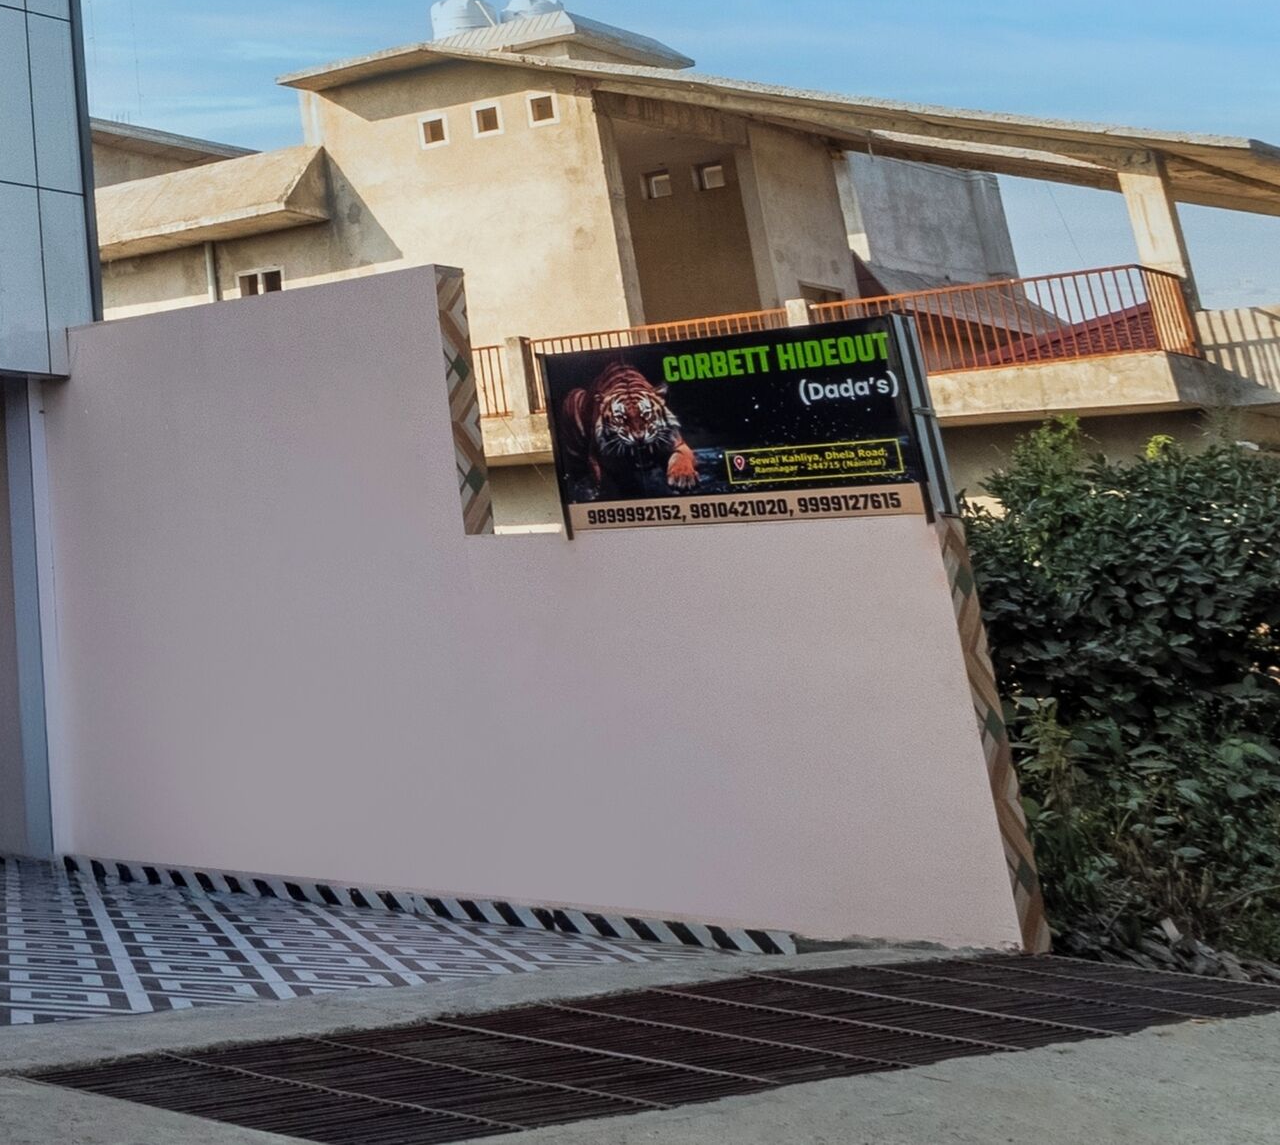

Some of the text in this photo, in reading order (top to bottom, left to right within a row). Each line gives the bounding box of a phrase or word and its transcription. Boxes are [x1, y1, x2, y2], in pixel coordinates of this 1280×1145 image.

[662, 332, 889, 382] CORBETT HIDEOUT
[799, 370, 899, 405] (Dada's)
[755, 464, 798, 474] Ramnagar
[807, 461, 840, 470] 244715
[842, 458, 886, 470] (Nainital)
[825, 451, 856, 461] Dhela
[587, 491, 902, 525] 9899992152, 9810421020, 9999127615
